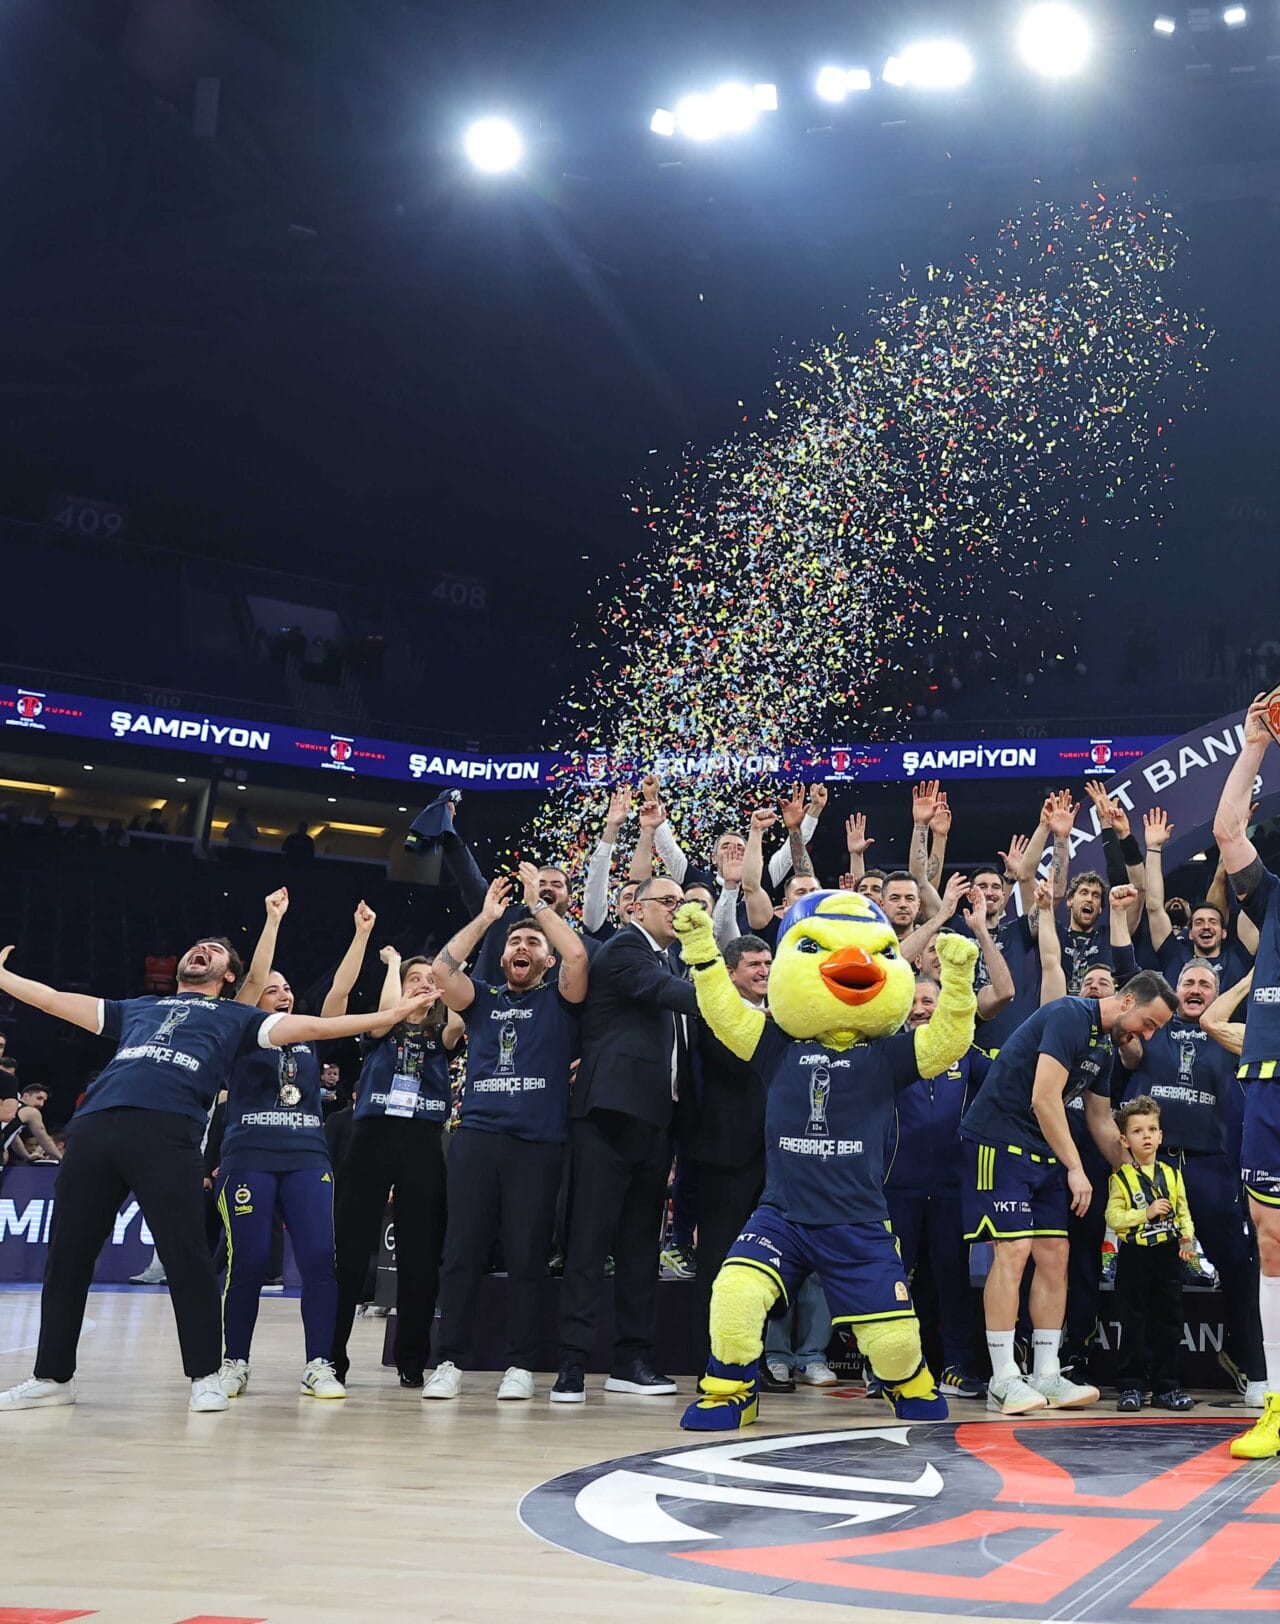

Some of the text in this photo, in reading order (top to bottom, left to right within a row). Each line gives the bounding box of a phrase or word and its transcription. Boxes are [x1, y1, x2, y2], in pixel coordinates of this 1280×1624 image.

[54, 505, 122, 537] 409
[432, 581, 485, 608] 408
[110, 711, 270, 750] ŞAMPİYON
[409, 754, 539, 780] ŞAMPİYON
[903, 745, 1036, 776] ŞAMPİYON
[993, 1201, 1018, 1213] YKT
